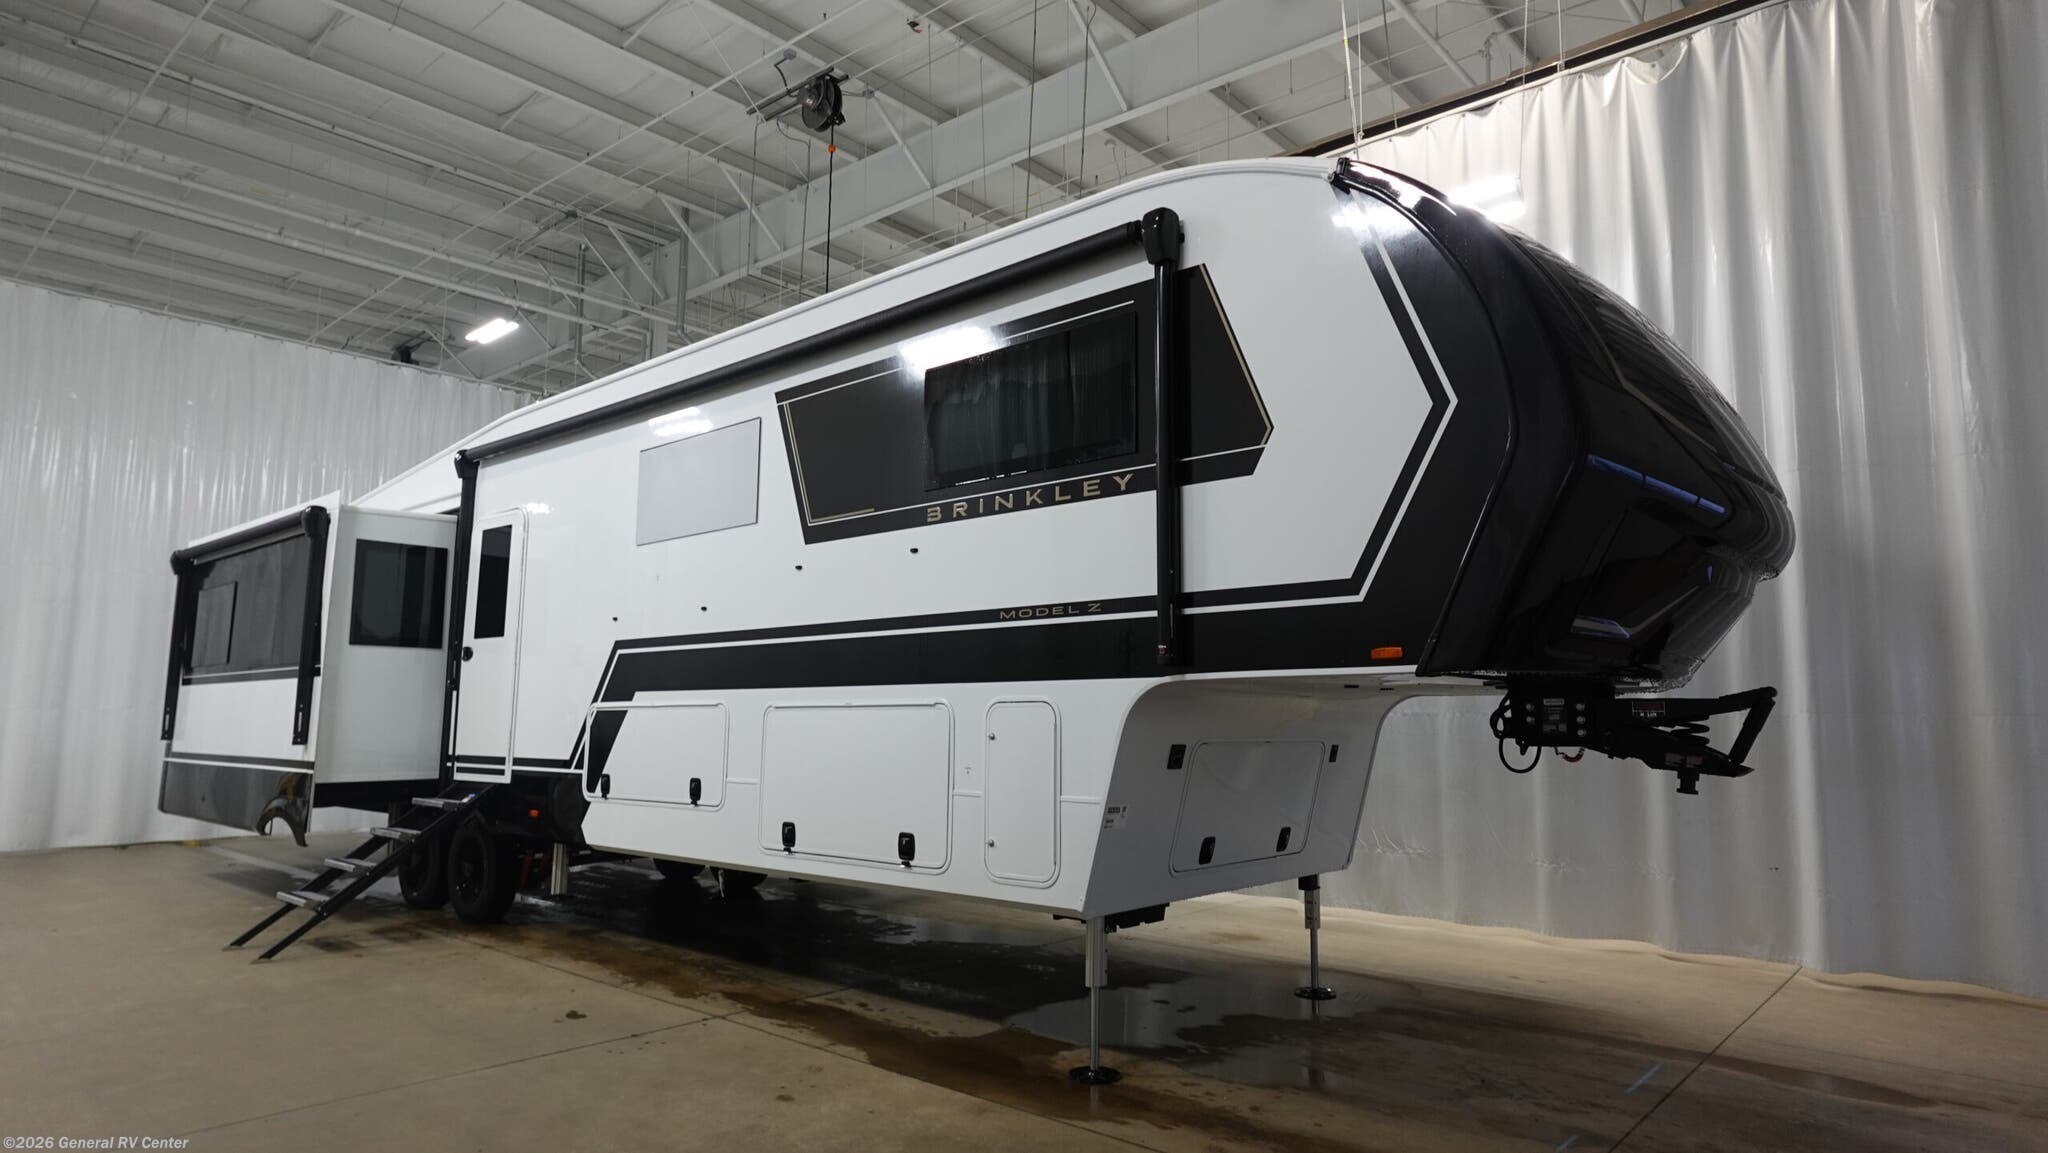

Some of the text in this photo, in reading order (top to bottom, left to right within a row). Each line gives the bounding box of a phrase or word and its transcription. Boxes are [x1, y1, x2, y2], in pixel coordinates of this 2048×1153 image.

[927, 473, 1133, 523] BRINKLEY
[1000, 602, 1101, 620] MODEL Z
